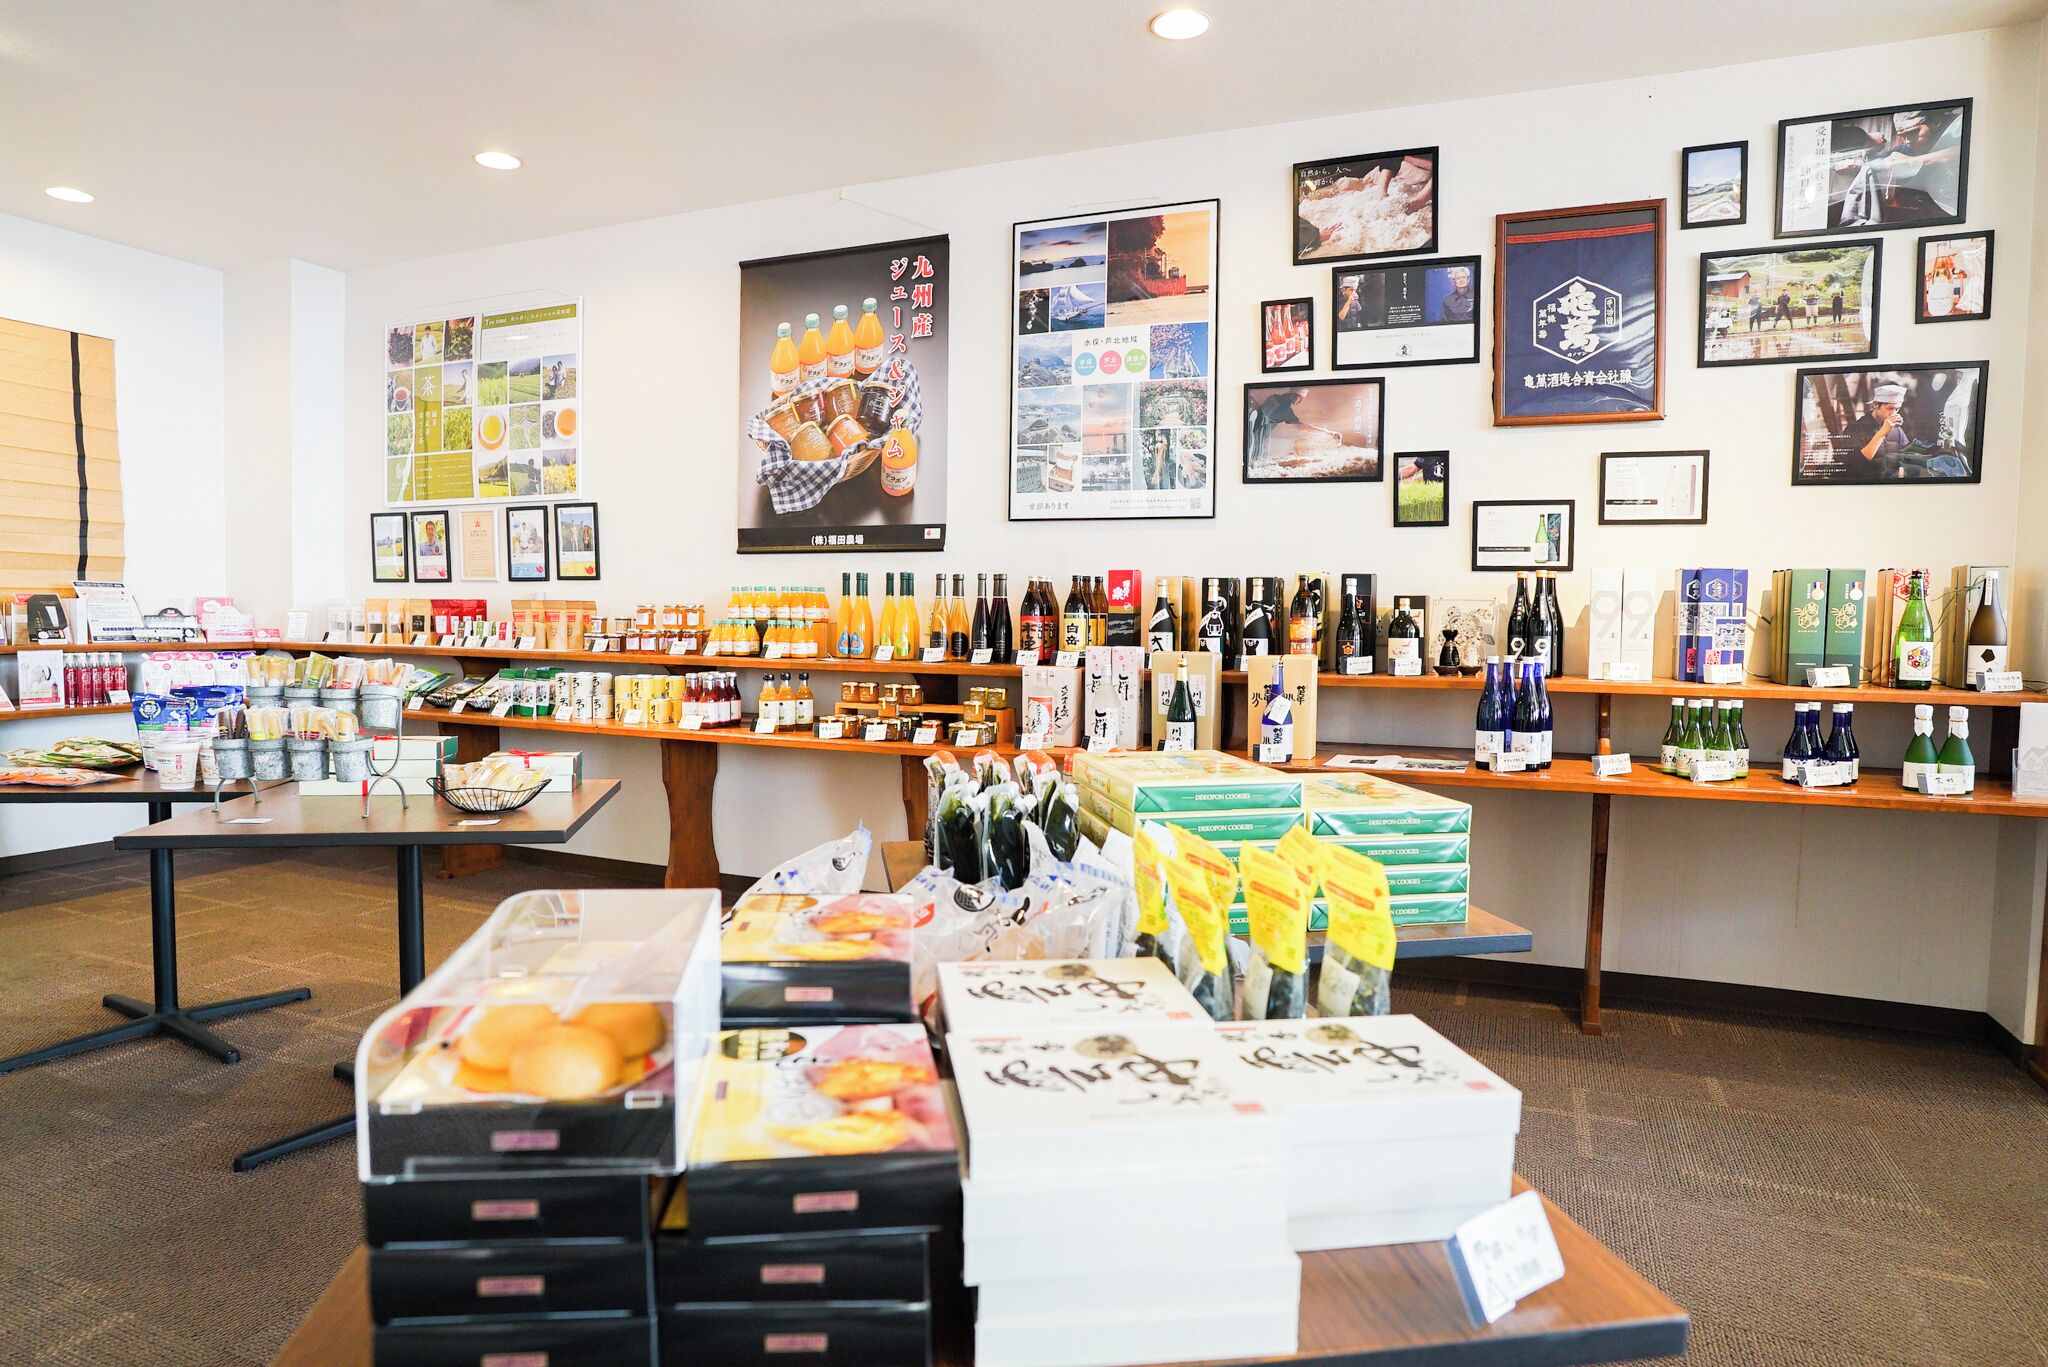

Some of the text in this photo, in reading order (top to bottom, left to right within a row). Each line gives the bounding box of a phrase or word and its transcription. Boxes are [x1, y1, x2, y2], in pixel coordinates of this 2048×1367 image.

[911, 255, 934, 338] 九州産
[420, 375, 436, 397] 茶
[811, 533, 864, 546] (株)福田農場
[1066, 623, 1079, 645] 白岳
[1395, 907, 1420, 915] COOKIES
